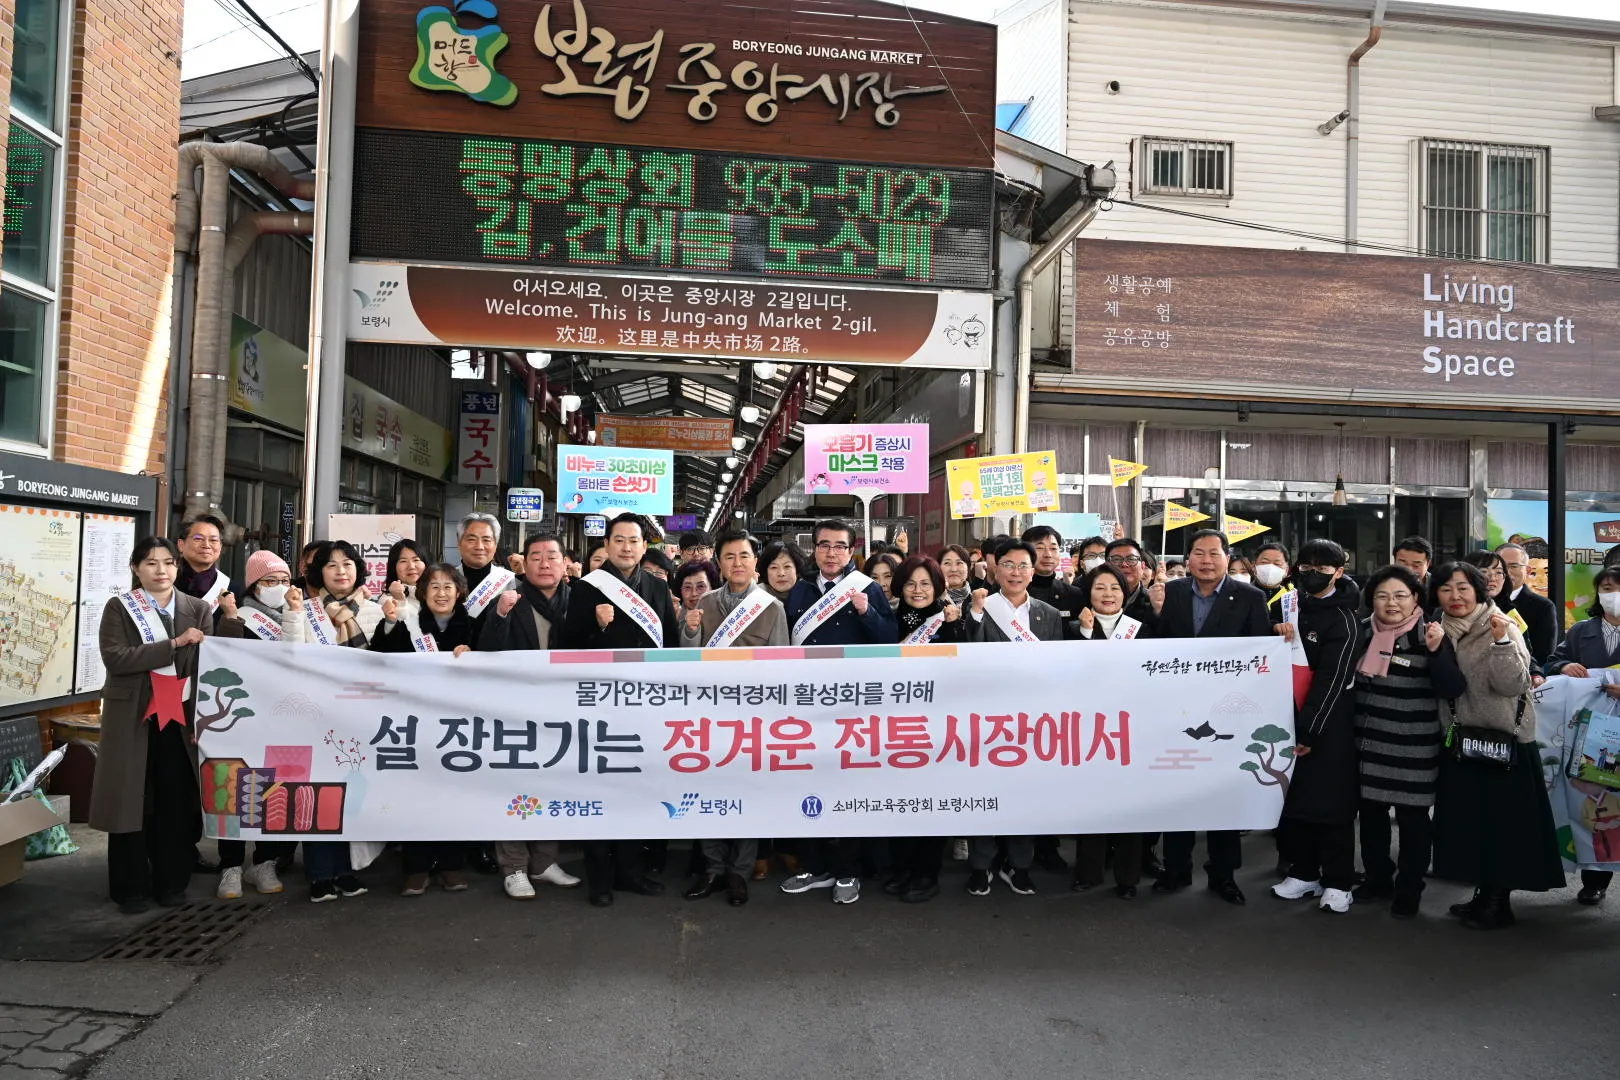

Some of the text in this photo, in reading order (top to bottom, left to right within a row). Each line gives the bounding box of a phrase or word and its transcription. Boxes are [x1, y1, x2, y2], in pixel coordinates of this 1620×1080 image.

[534, 0, 950, 127] 보령 중앙시장
[732, 39, 923, 65] BORYEONG JUNGANG MARKET
[459, 139, 951, 227] 동명상회 935-5029
[764, 216, 936, 282] 도소매
[512, 278, 852, 312] 어서오세요. 이곳은 중앙시장 2길입니다.
[1104, 273, 1173, 295] 생활공예
[1423, 272, 1516, 313] Living
[360, 315, 392, 328] 보령시
[485, 297, 877, 335] Welcome. This is Jung-ang Market 2-gil.
[1423, 309, 1576, 345] Handcraft
[1103, 327, 1173, 350] 공유공방
[1422, 346, 1516, 382] Space
[463, 394, 497, 411] 풍년
[462, 418, 496, 482] 국수
[874, 437, 911, 451] 증상시
[566, 455, 667, 476] 비누로 30초이상
[828, 453, 905, 473] 마스크 착용
[578, 475, 657, 494] 올바른 손씻기
[981, 470, 1023, 486] 매년 1회
[18, 479, 68, 498] BORYEONG
[70, 487, 110, 503] JUNGANG
[111, 492, 139, 506] MARKET
[1565, 548, 1604, 566] 여기는
[575, 680, 935, 708] 물가안정과 지역경제 활성화를 위해
[369, 709, 1132, 774] 설 장보기는 정겨운 전통시장에서
[547, 798, 604, 818] 충청남도
[698, 797, 742, 816] 보령시
[831, 796, 999, 814] 소비자교육중앙회 보령시지회
